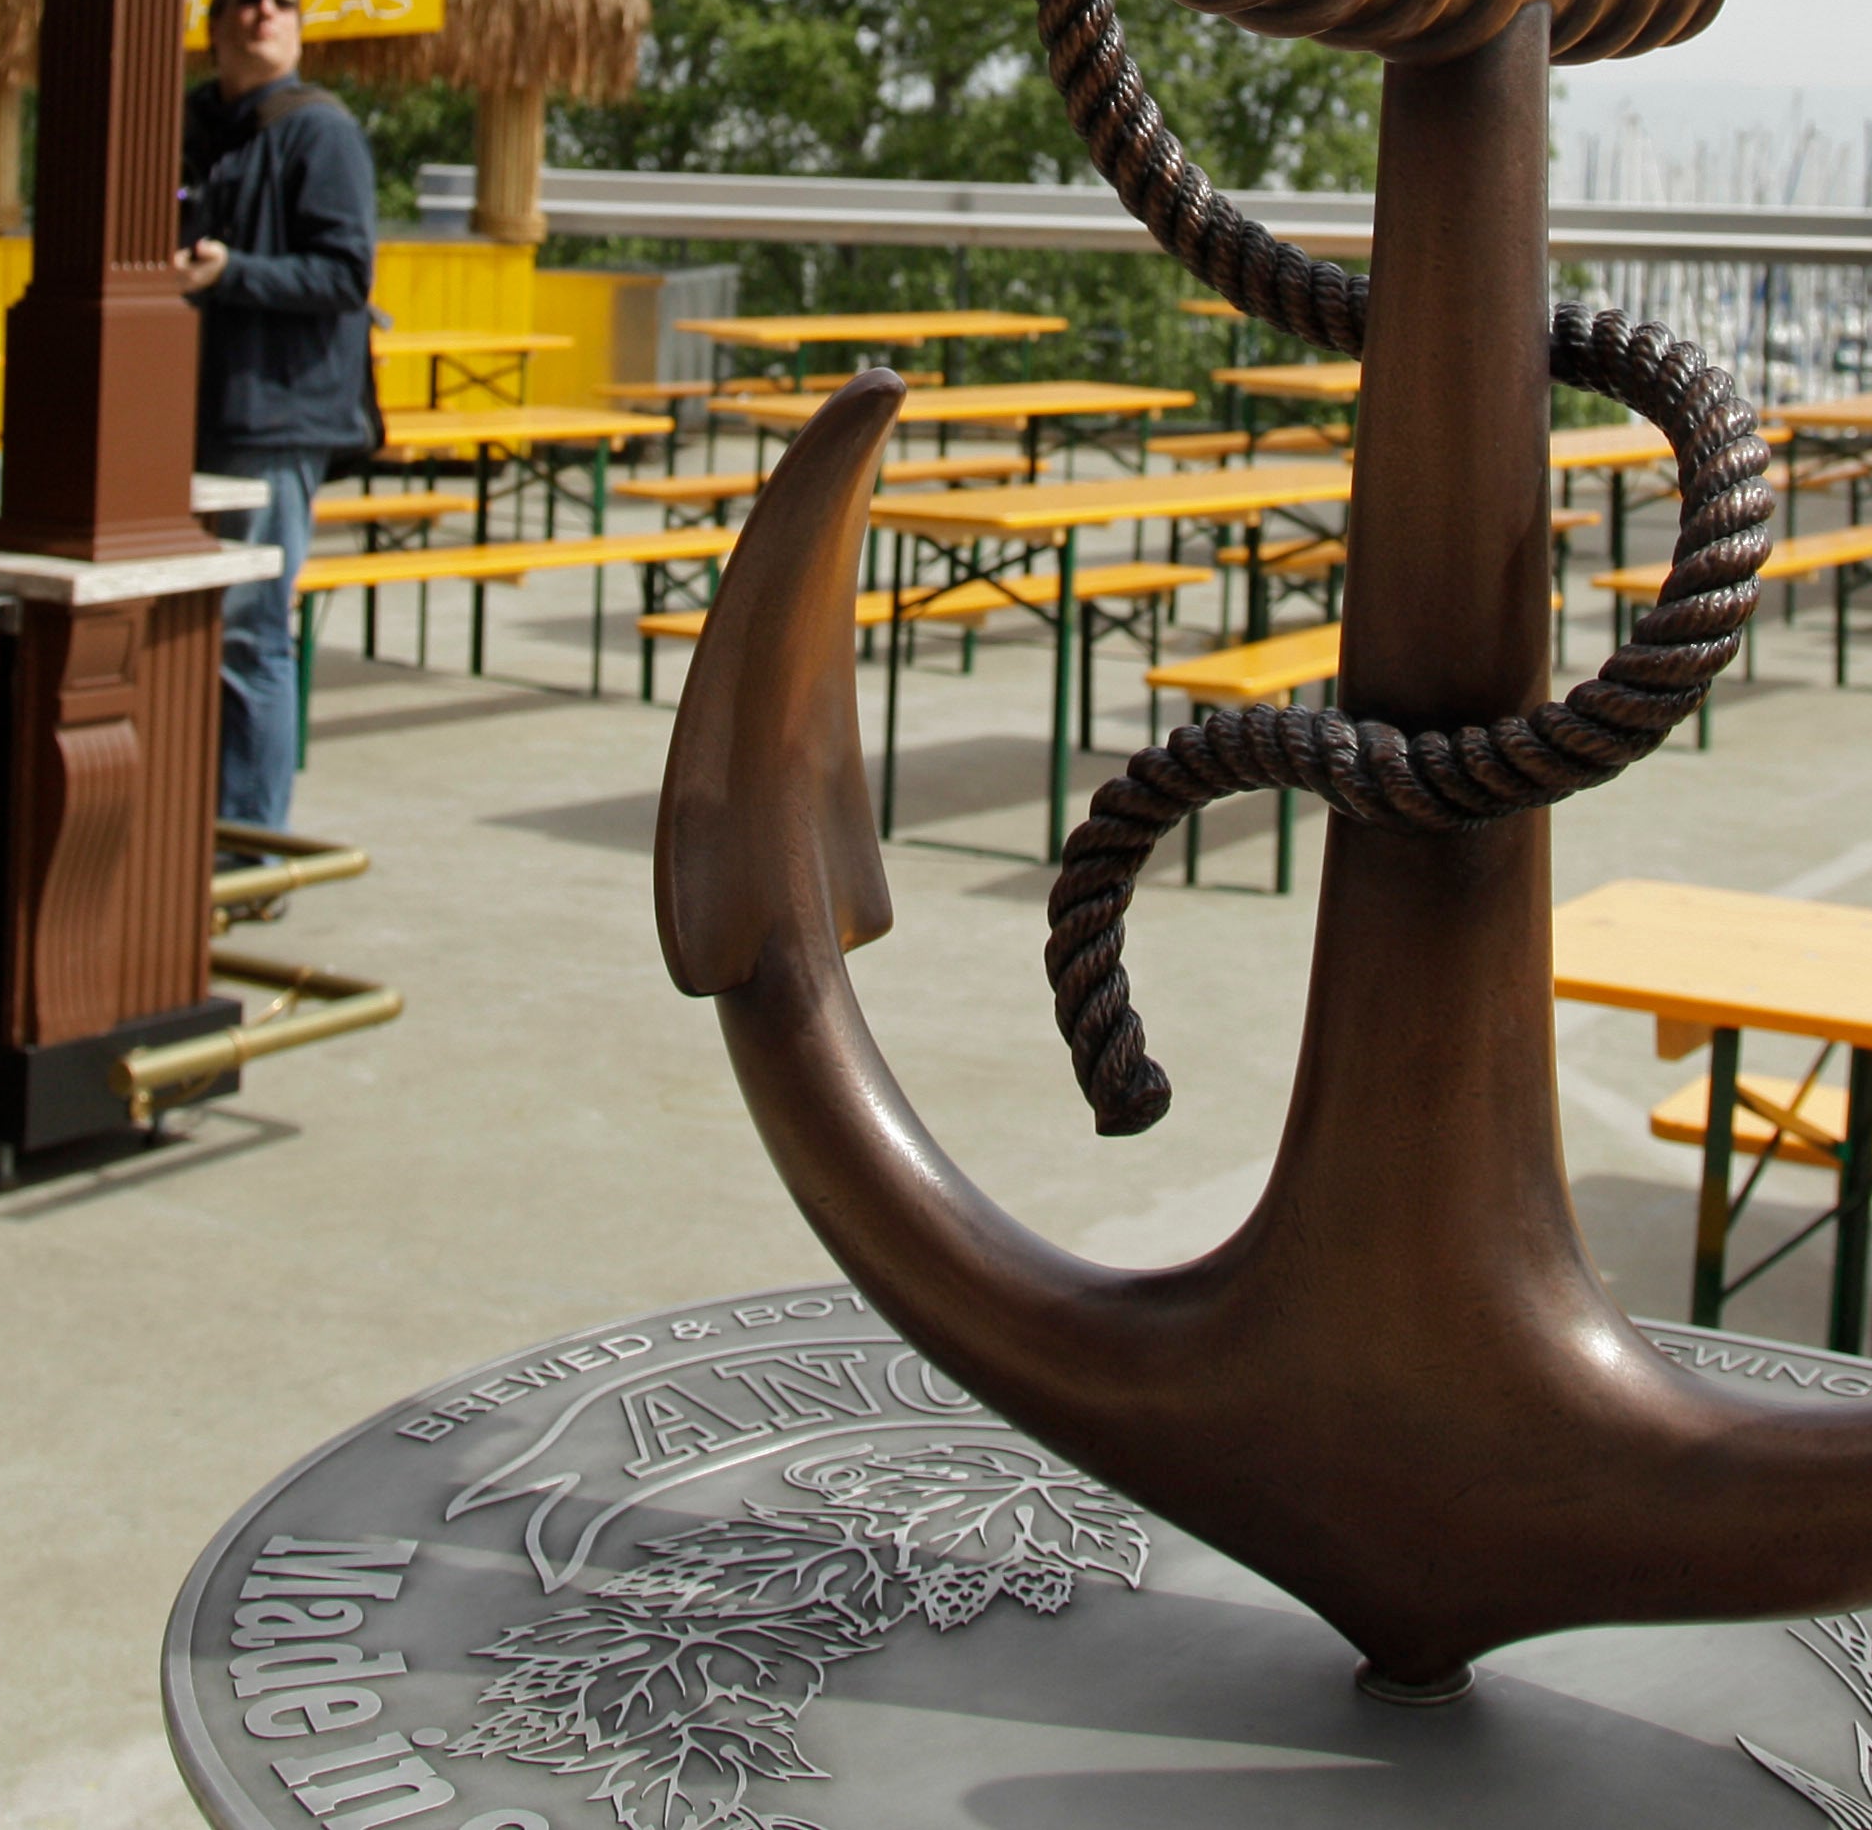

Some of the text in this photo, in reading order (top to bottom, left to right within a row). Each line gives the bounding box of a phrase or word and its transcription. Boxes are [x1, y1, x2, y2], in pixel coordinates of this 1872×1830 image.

[397, 1334, 654, 1443] BREWED
[229, 1535, 457, 1830] Made in
